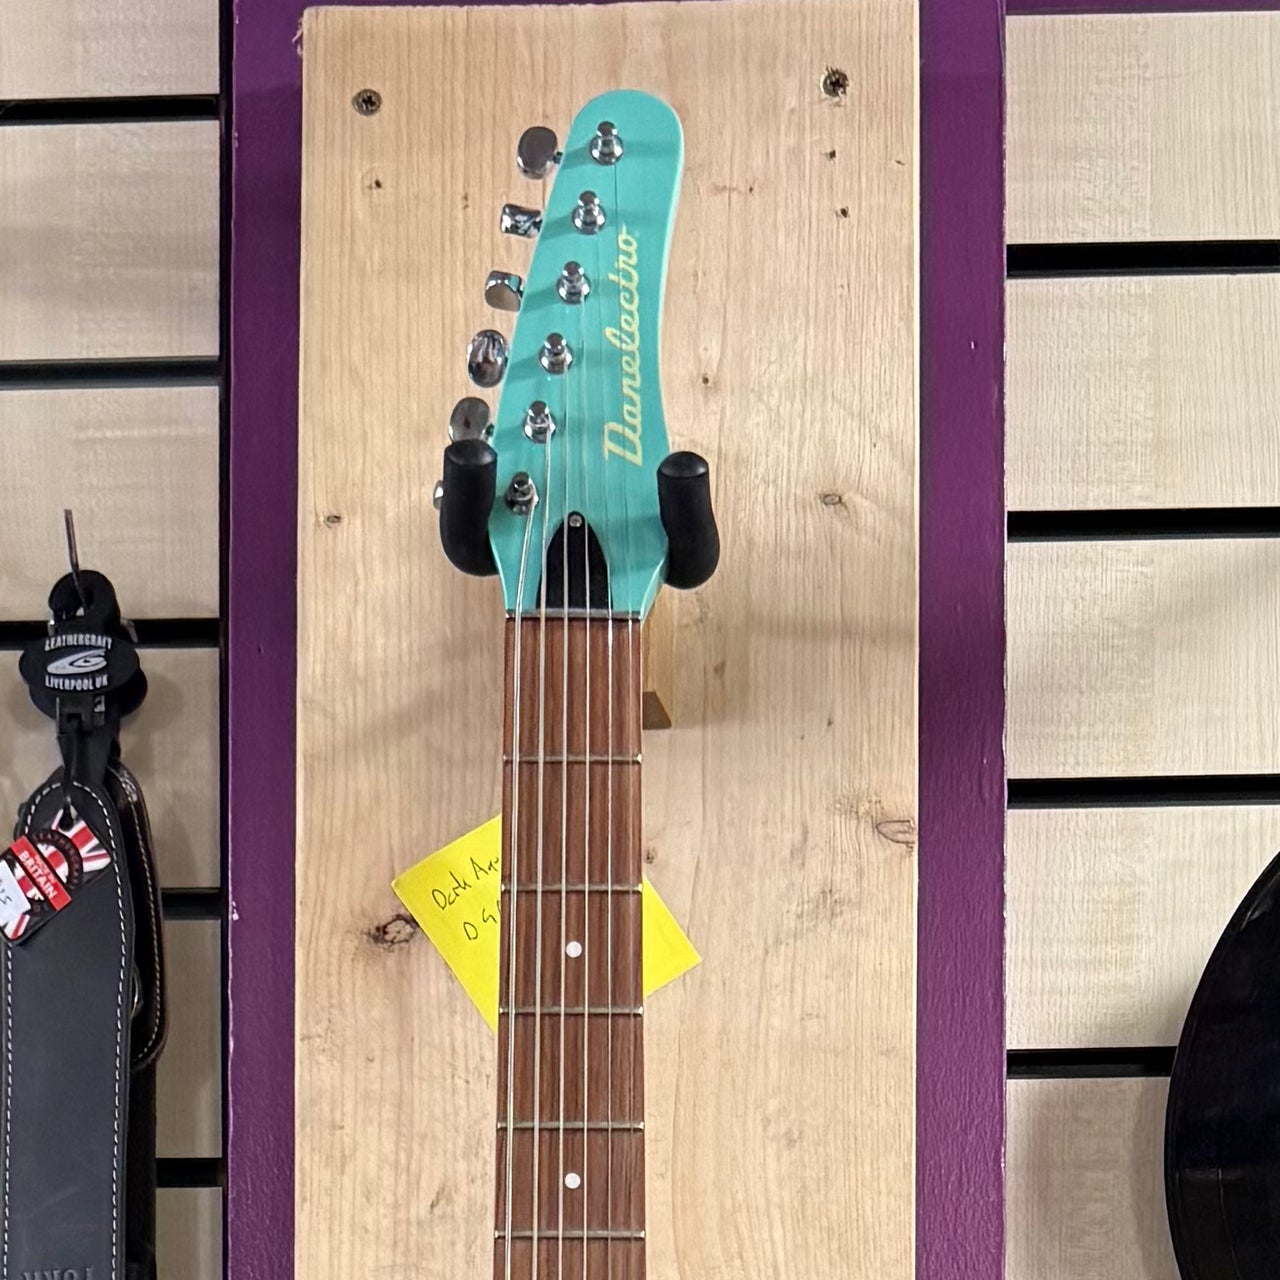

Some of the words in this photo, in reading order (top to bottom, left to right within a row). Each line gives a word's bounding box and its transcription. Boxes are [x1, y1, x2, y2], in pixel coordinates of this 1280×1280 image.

[602, 224, 640, 468] Danelectro
[44, 674, 93, 691] LIVERPOOL
[95, 674, 108, 687] UK
[19, 850, 58, 899] BRITAIN
